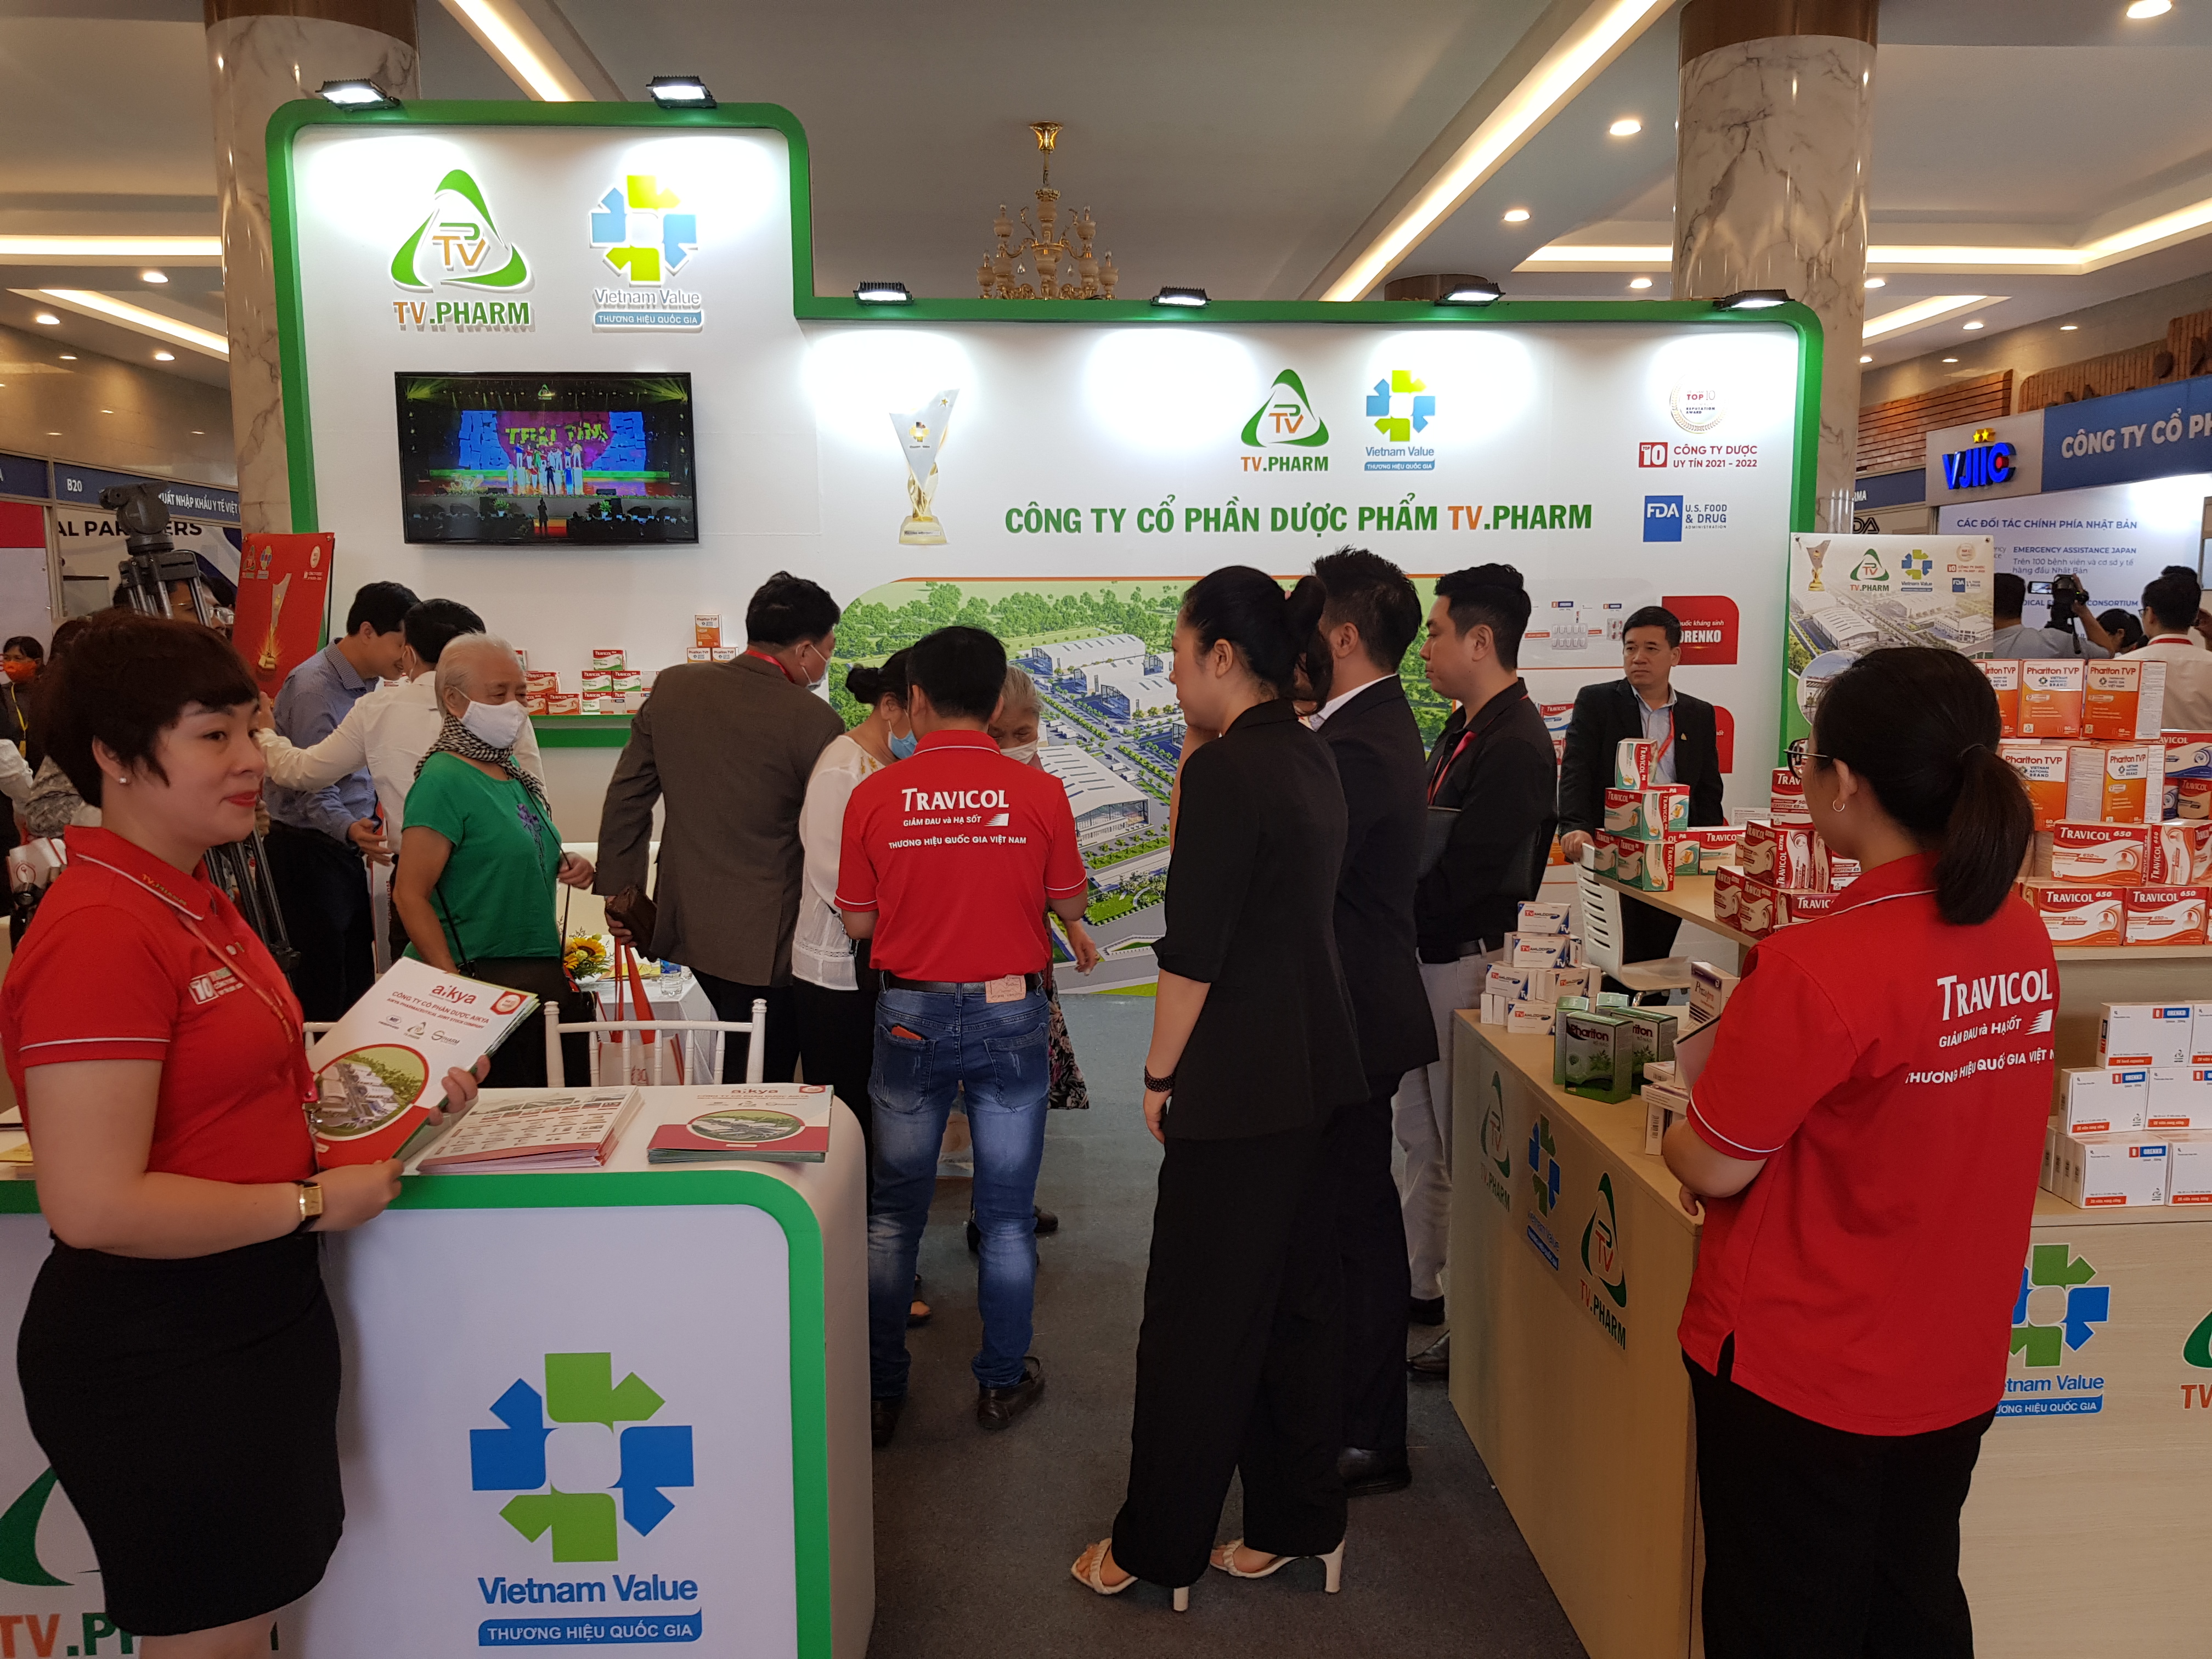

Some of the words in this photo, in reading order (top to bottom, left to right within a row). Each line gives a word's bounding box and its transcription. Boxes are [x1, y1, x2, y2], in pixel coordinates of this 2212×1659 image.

[595, 289, 656, 304] Vietnam
[659, 290, 699, 304] Value
[393, 302, 530, 324] TV.PHARM
[598, 315, 634, 323] THƯƠNG
[637, 314, 655, 324] HIỆU
[658, 314, 681, 324] QUỐC
[2062, 429, 2115, 459] CÔNG
[2121, 424, 2148, 449] TY
[2152, 408, 2183, 444] CỔ
[1365, 447, 1406, 456] Vietnam
[1408, 446, 1434, 456] Value
[1641, 445, 1666, 466] 10
[1674, 444, 1707, 455] CÔNG
[1710, 446, 1723, 454] TY
[1726, 445, 1758, 456] DƯỢC
[1240, 456, 1328, 472] TV.PHARM
[1688, 458, 1703, 467] TÍN
[67, 478, 82, 492] B20
[176, 494, 194, 509] NHẬP
[195, 494, 212, 510] KHẨU
[212, 500, 217, 511] Y
[217, 498, 225, 512] TẾ
[225, 500, 238, 516] VIỆT
[1647, 503, 1679, 518] FDA
[1685, 504, 1701, 512] U.S.
[1705, 504, 1727, 512] FOOD
[1005, 501, 1081, 533] CÔNG
[1091, 508, 1126, 533] TY
[1137, 494, 1175, 533] CỔ
[1185, 496, 1259, 532] PHẦN
[1271, 502, 1347, 537] DƯỢC
[1358, 493, 1437, 531] PHẨM
[1448, 504, 1592, 530] TV.PHARM
[1685, 515, 1693, 523] &
[1697, 514, 1726, 523] DRUG
[1957, 520, 1978, 528] CÁC
[1980, 518, 1999, 528] ĐỐI
[2002, 519, 2021, 528] TÁC
[2024, 518, 2056, 528] CHÍNH
[2059, 518, 2083, 528] PHÍA
[2086, 520, 2114, 531] NHẬT
[2116, 518, 2137, 529] BẢN
[2047, 558, 2067, 567] bệnh
[2012, 567, 2033, 575] hàng
[1639, 746, 1647, 774] TRAVICOL
[2005, 755, 2042, 764] Phariton
[902, 788, 1009, 812] TRAVICOL
[1607, 791, 1629, 802] TRAVICOL
[903, 816, 923, 827] GIẢM
[953, 816, 964, 825] HẠ
[966, 814, 981, 823] SỐT
[1706, 833, 1736, 842] TRAVICO
[2060, 827, 2111, 840] TRAVICOL
[888, 839, 922, 849] THƯƠNG
[924, 836, 943, 847] HIỆU
[945, 834, 970, 844] QUỐC
[990, 834, 1008, 845] VIỆT
[1776, 851, 1787, 885] TRAVICOL
[2151, 845, 2161, 879] TRAVICOL
[2046, 891, 2094, 902] TRAVICOL
[2132, 891, 2179, 902] TRAVICOL
[1560, 924, 1568, 933] TV
[1556, 959, 1565, 967] TV
[1937, 968, 2053, 1021] TRAVICOL
[392, 991, 411, 1001] CÔNG
[470, 1015, 490, 1024] AIKYA
[1570, 1024, 1609, 1042] Phariton
[1979, 1024, 1988, 1036] và
[1991, 1023, 2006, 1035] HẠ
[2007, 1053, 2026, 1065] GIA
[2029, 1047, 2047, 1064] VIỆT
[1581, 1279, 1626, 1350] TV.PHARM
[2006, 1378, 2051, 1392] tnam
[2056, 1374, 2104, 1390] Value
[2025, 1402, 2047, 1414] HIỆU
[2050, 1400, 2078, 1412] QUỐC
[2080, 1402, 2096, 1410] GIA
[478, 1577, 605, 1604] Vietnam
[612, 1573, 698, 1601] Value
[487, 1626, 561, 1640] THƯƠNG
[567, 1624, 604, 1641] HIỆU
[610, 1619, 658, 1639] QUỐC
[664, 1624, 693, 1637] GIA
